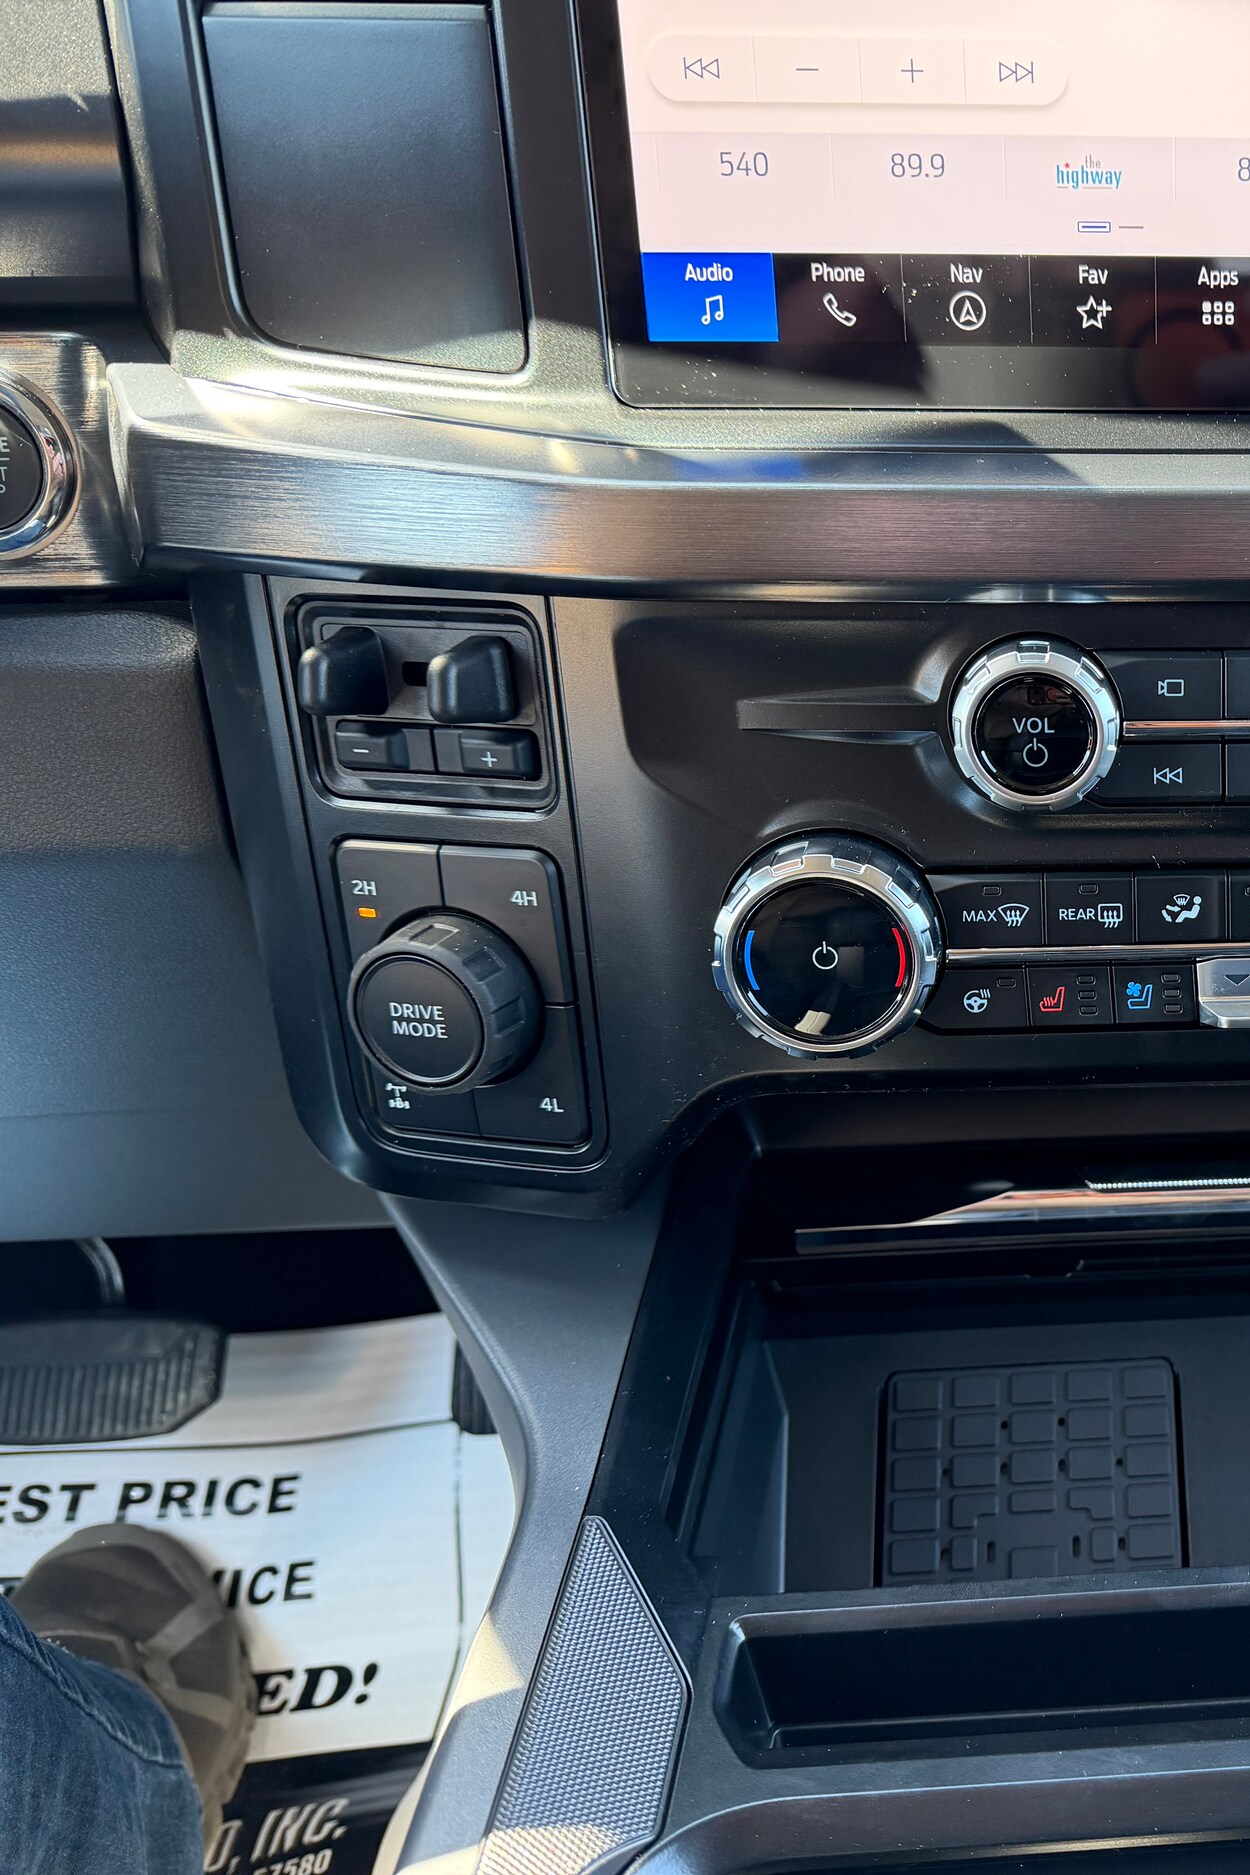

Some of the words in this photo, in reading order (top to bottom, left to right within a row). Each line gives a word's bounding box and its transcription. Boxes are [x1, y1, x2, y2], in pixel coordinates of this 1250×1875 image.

[718, 151, 769, 178] 540
[889, 152, 946, 179] 89.9
[1084, 154, 1101, 170] the
[1056, 163, 1122, 190] highway
[684, 262, 734, 284] Audio
[810, 263, 866, 284] Phone
[950, 264, 983, 285] Nav
[1078, 265, 1109, 285] Fav
[1197, 267, 1239, 292] Apps
[1012, 718, 1055, 734] VOL
[351, 880, 377, 896] 2H
[510, 891, 538, 907] 4H
[962, 908, 996, 923] MAX
[1058, 906, 1095, 921] REAR
[389, 1002, 445, 1021] DRIVE
[392, 1020, 448, 1039] MODE
[539, 1097, 564, 1113] 4L
[116, 1474, 300, 1524] PRICE
[211, 1561, 316, 1609] ICE
[250, 1797, 350, 1864] INC.
